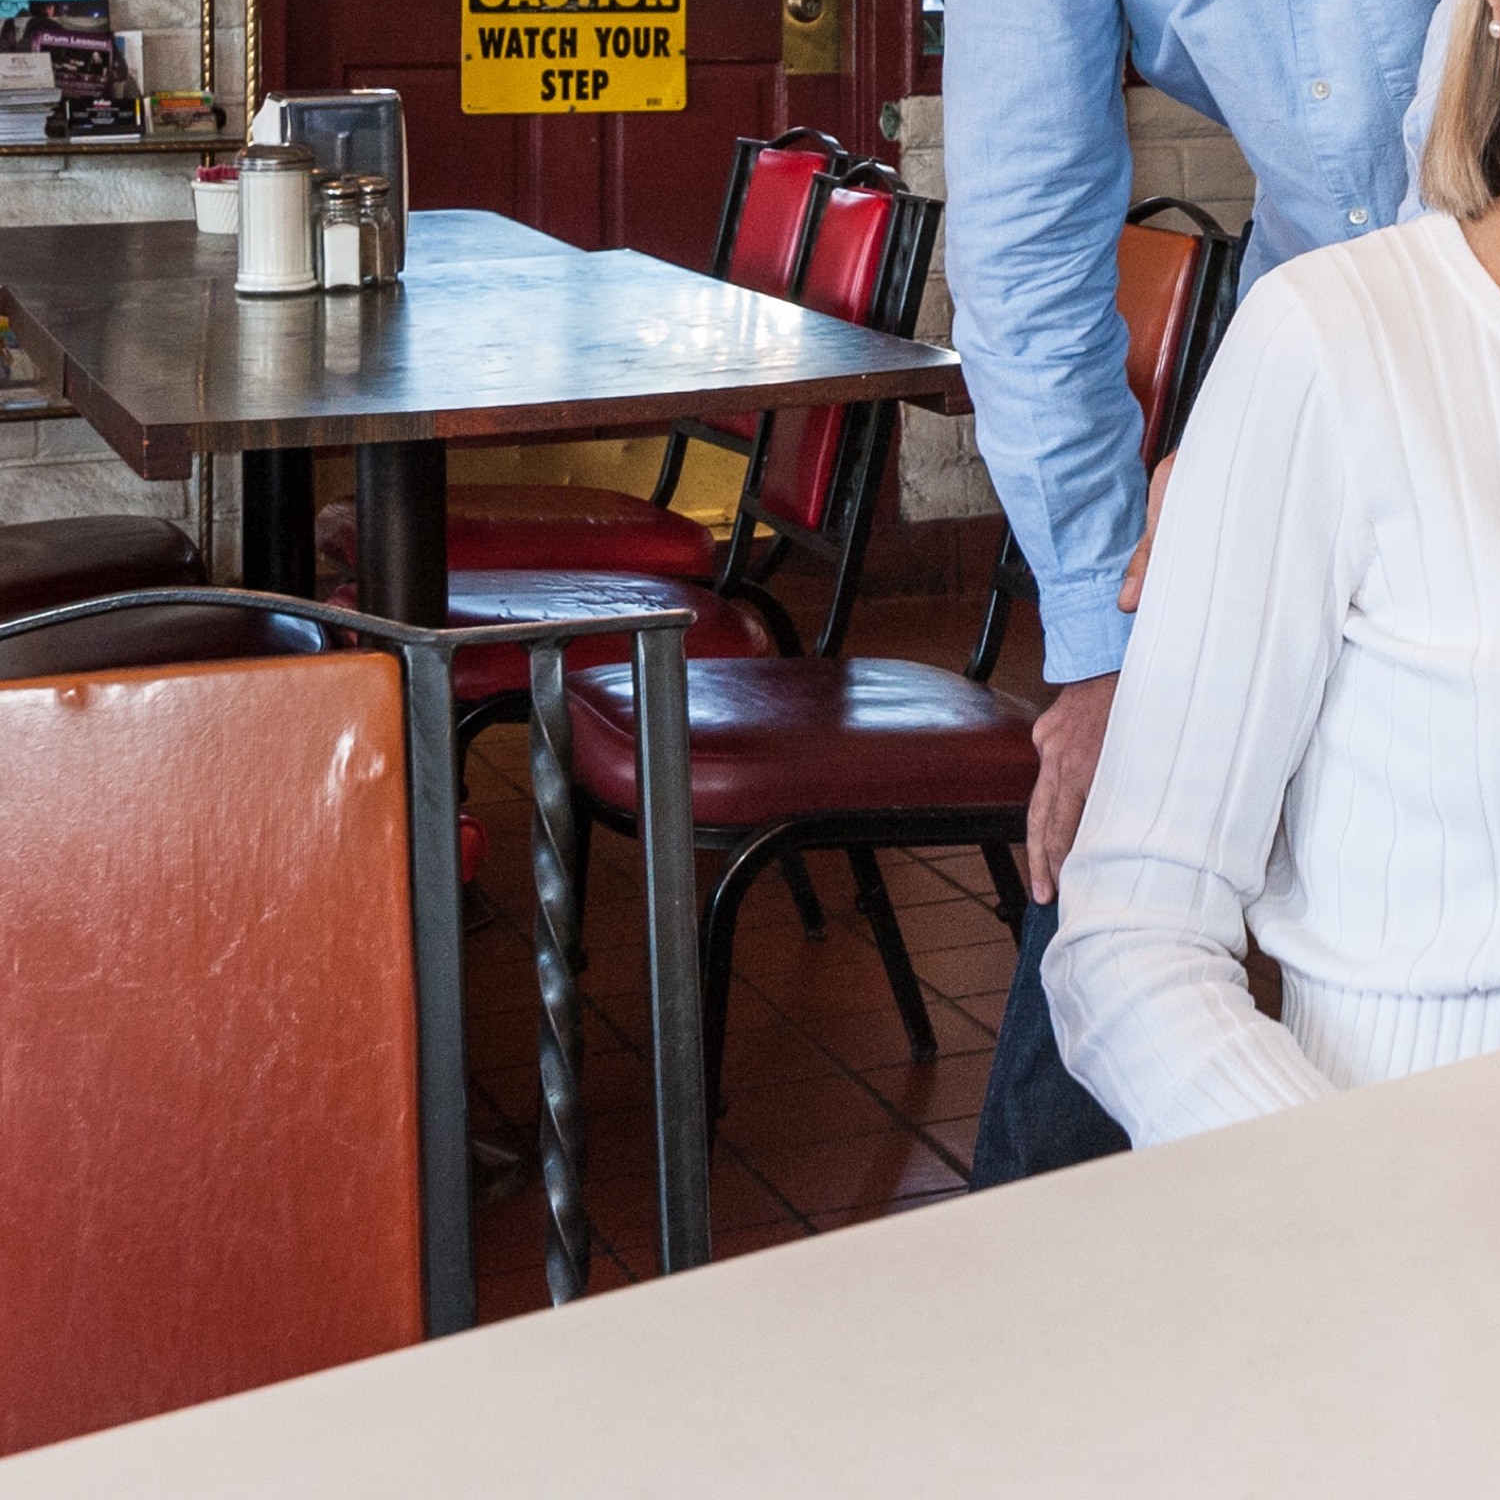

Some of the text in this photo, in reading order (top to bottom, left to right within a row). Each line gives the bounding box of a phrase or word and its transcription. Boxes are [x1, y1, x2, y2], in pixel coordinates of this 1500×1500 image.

[43, 33, 108, 48] Drum Lessons
[478, 25, 672, 59] WATCH YOUR
[540, 68, 610, 102] STEP
